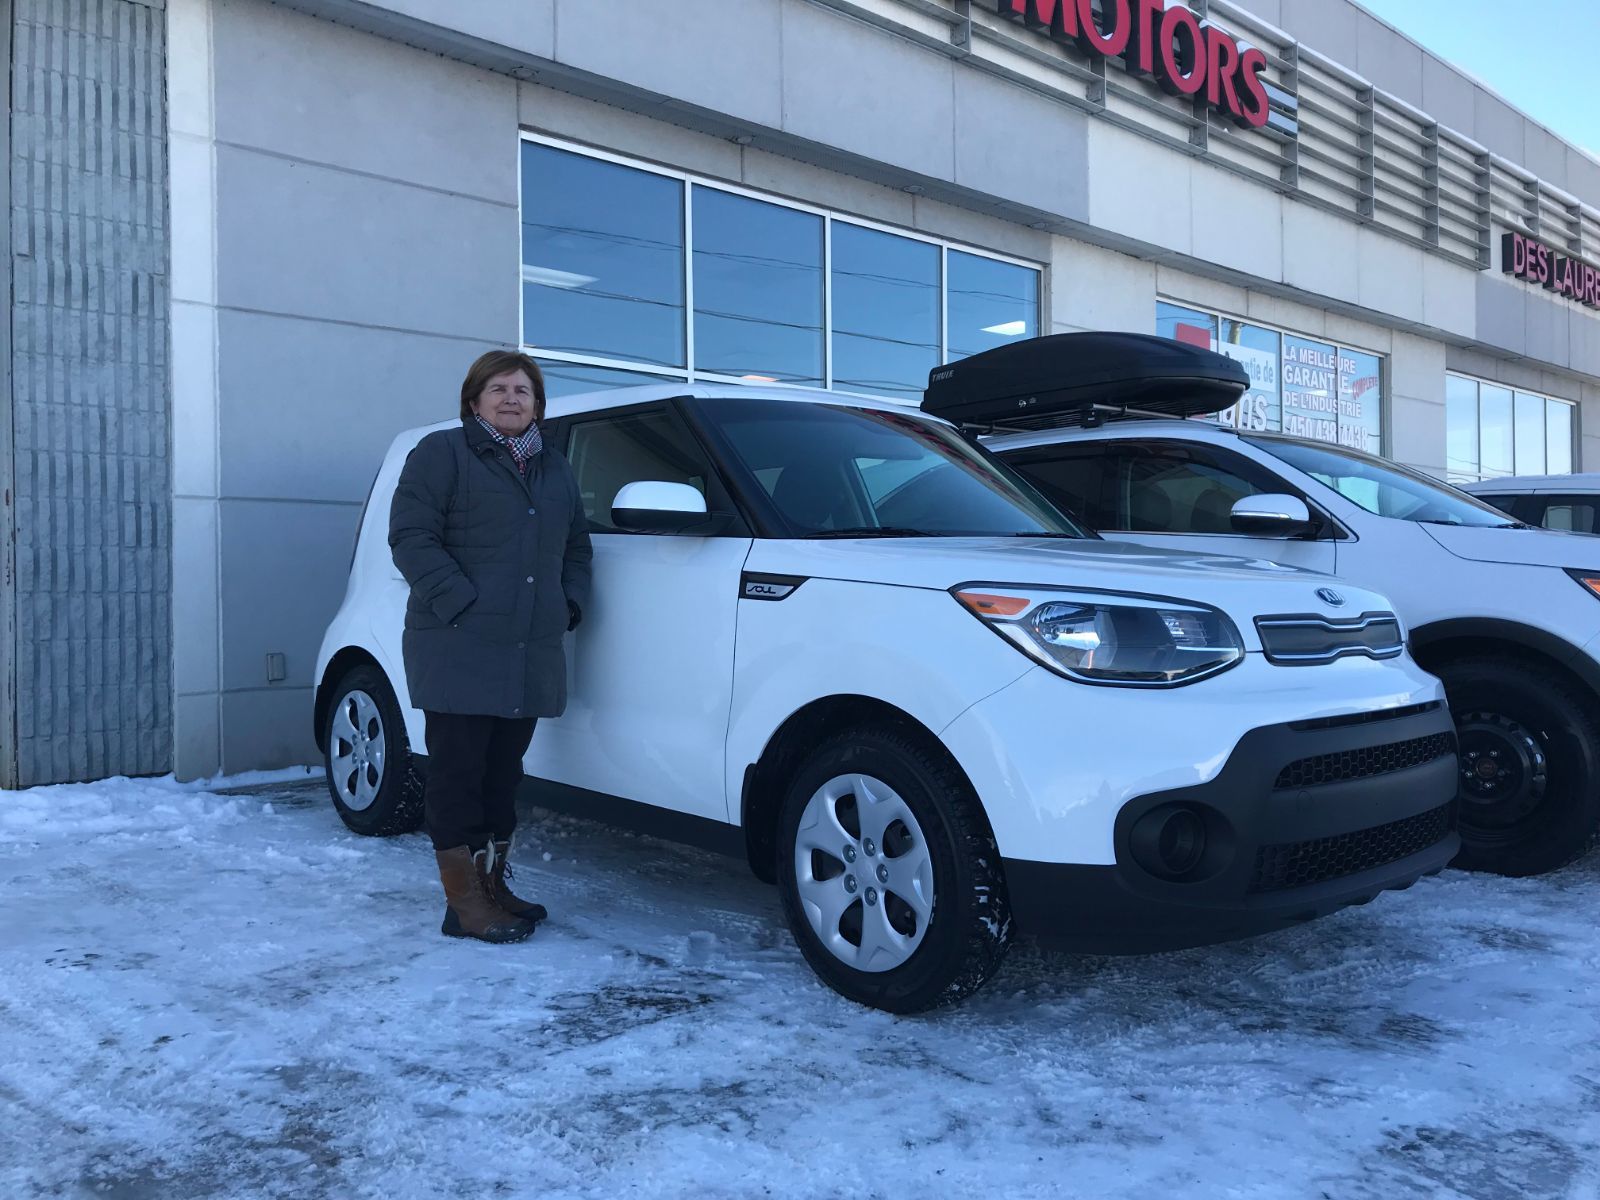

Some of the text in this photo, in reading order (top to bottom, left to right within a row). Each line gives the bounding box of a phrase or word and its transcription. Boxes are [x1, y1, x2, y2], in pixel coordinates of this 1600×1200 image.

[1513, 232, 1548, 283] DES
[1263, 360, 1274, 384] de
[1283, 344, 1356, 374] LA MEILLEURE
[1284, 364, 1349, 394] GARANTE
[1283, 391, 1298, 407] DE
